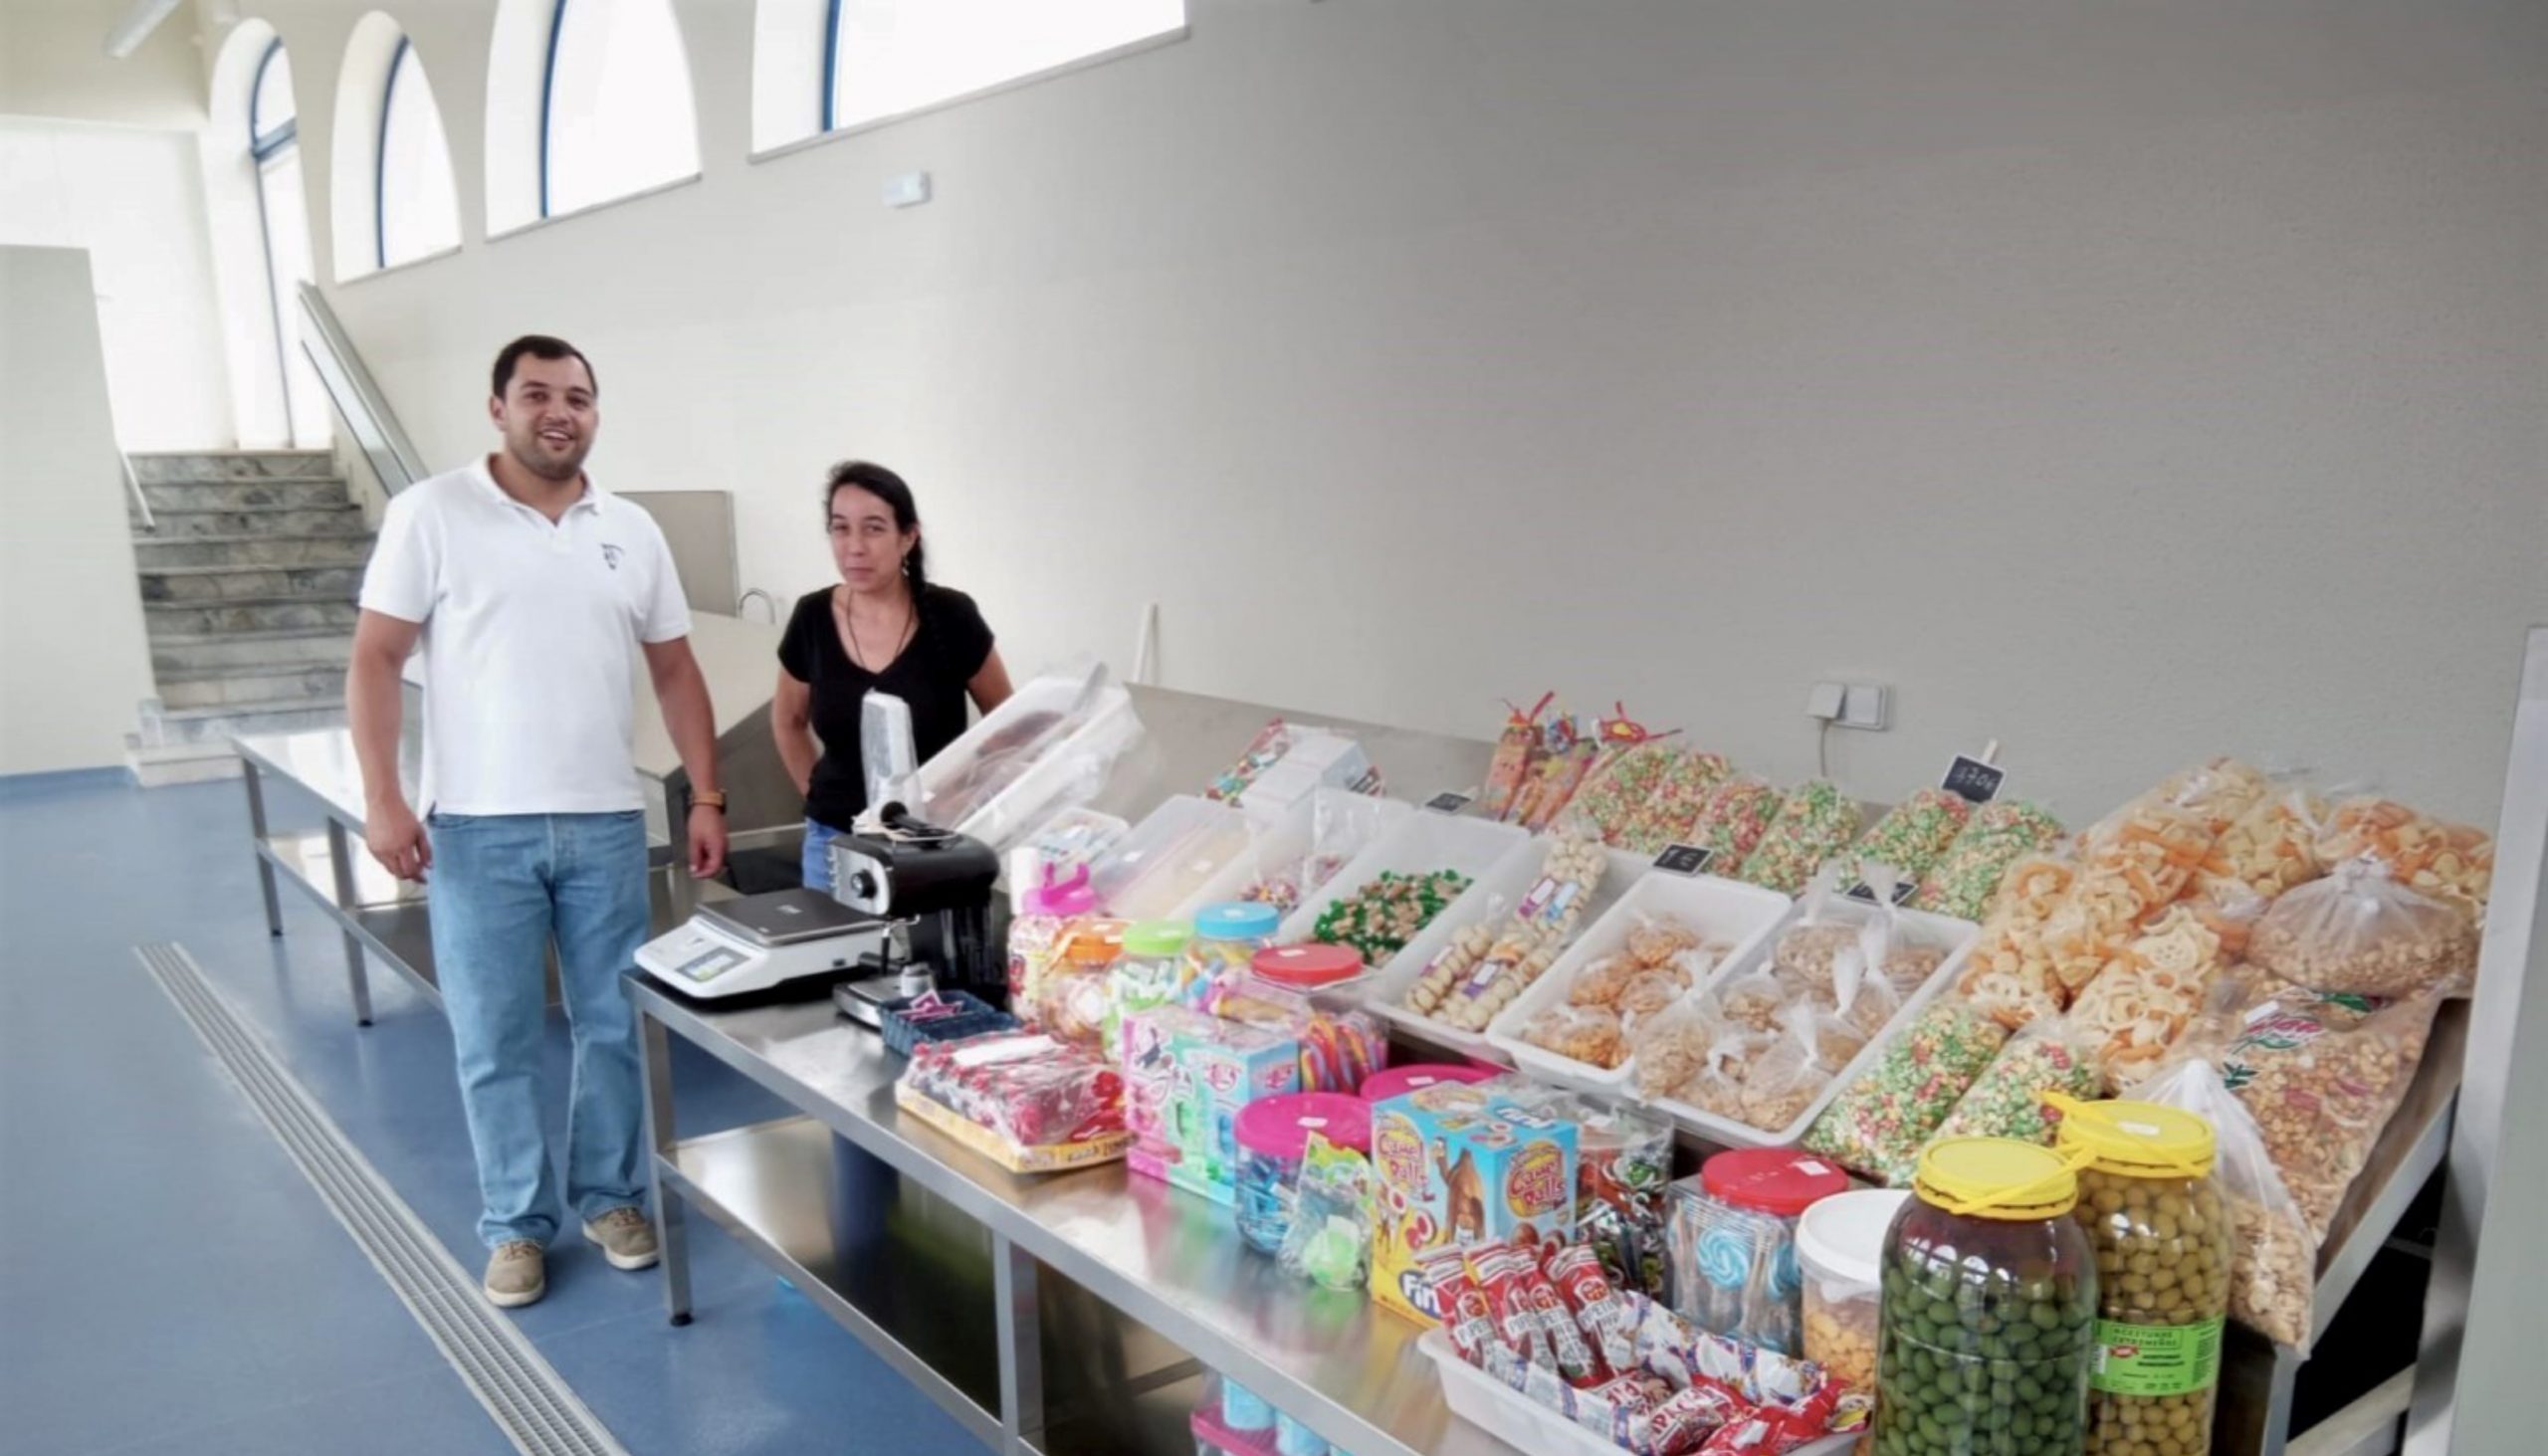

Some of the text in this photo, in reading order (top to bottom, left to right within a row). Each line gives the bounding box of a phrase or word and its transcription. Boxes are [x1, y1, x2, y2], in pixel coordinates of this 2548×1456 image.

[1377, 1129, 1424, 1156] Camel
[1389, 1158, 1429, 1187] Balls
[1400, 1272, 1442, 1320] Fin
